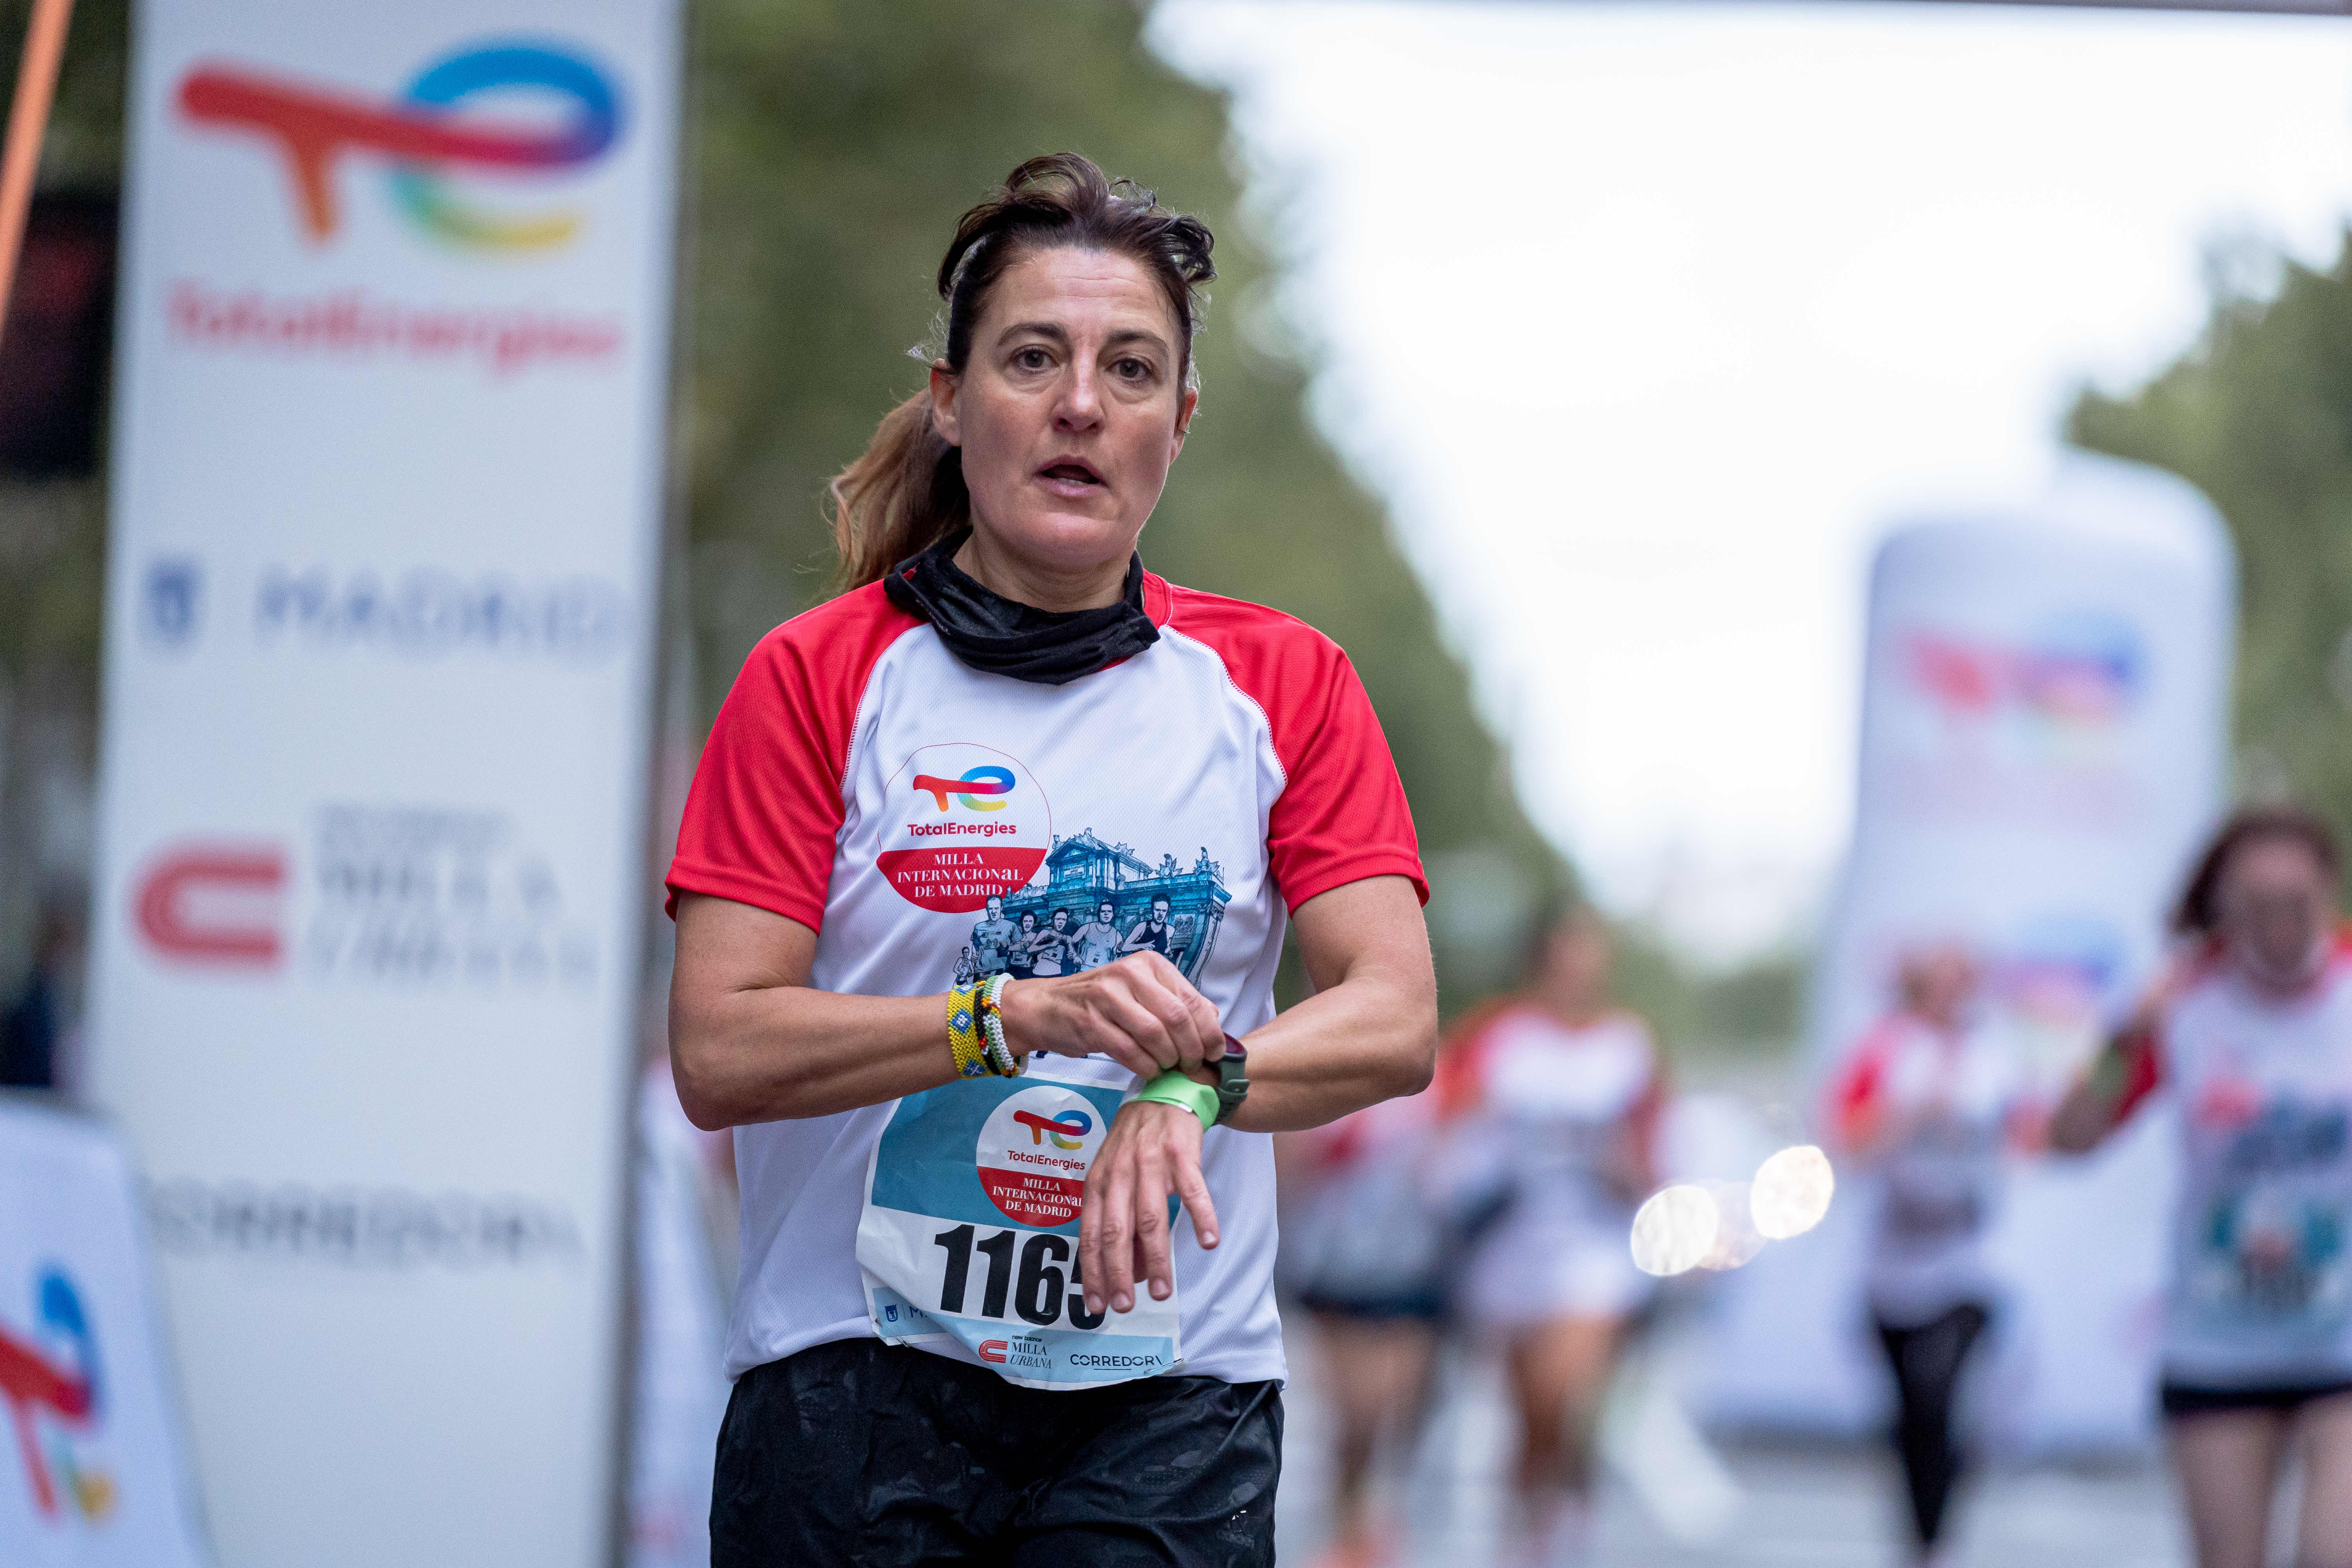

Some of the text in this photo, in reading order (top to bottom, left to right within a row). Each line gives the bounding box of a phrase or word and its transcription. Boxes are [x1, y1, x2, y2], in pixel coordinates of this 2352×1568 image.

[907, 821, 1016, 837] TotalEnergies
[935, 853, 984, 865] MILLA
[915, 884, 1003, 897] DE MADRID
[1007, 1150, 1085, 1171] TotalEnergies
[1023, 1178, 1061, 1191] MILLA
[1005, 1200, 1071, 1217] DE MADRID
[1013, 1342, 1047, 1356] MILLA
[1010, 1354, 1051, 1368] URBANA
